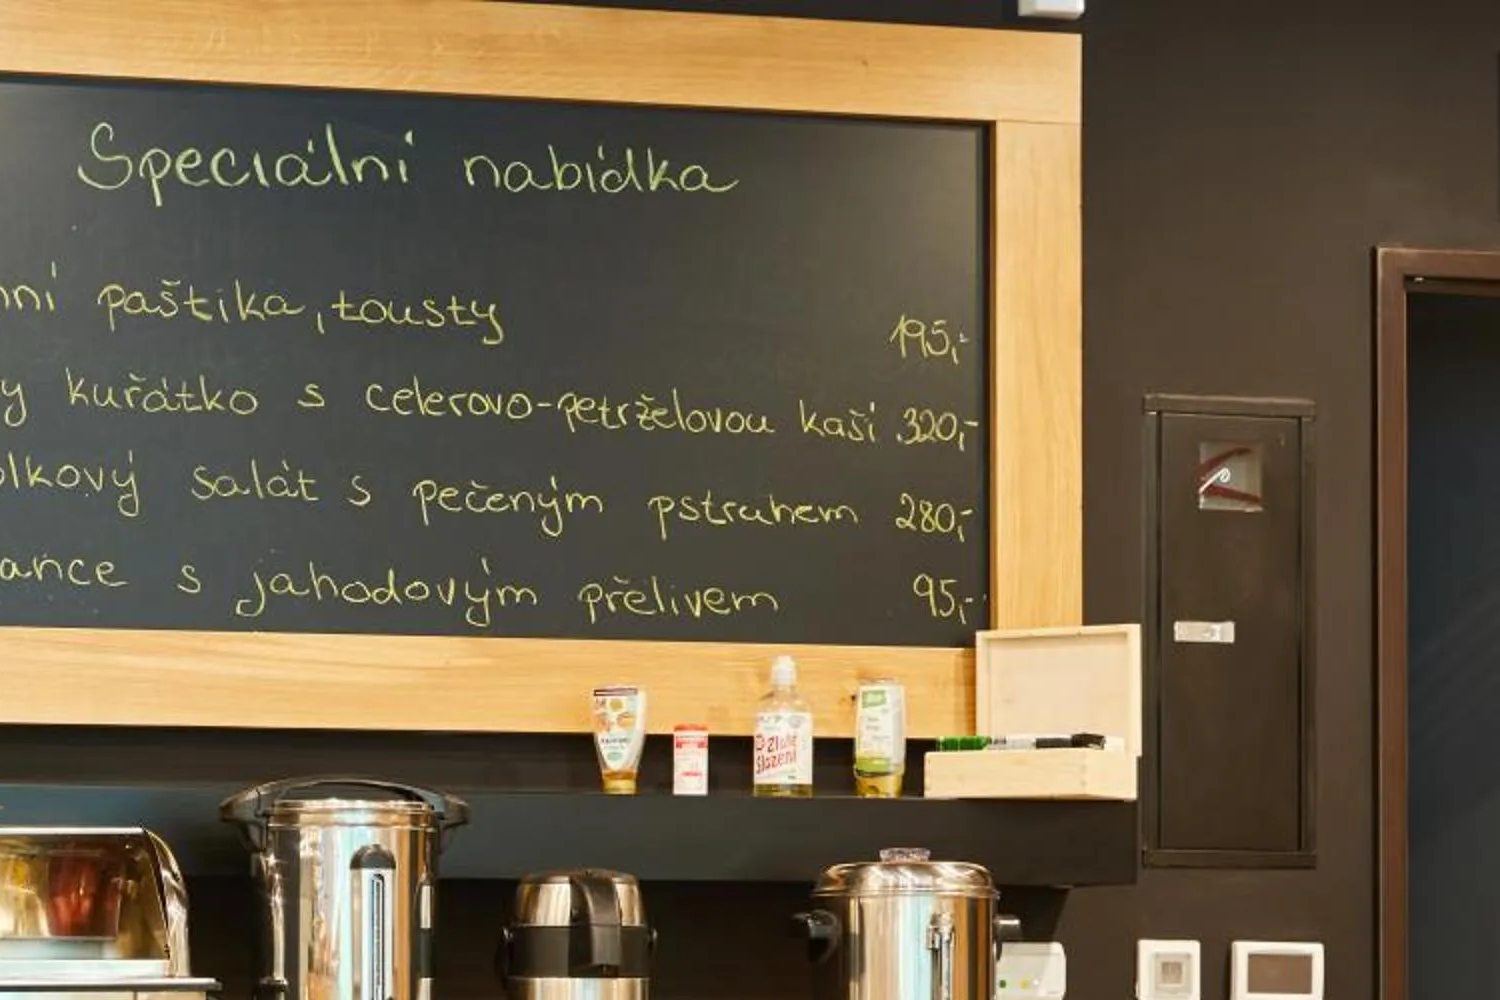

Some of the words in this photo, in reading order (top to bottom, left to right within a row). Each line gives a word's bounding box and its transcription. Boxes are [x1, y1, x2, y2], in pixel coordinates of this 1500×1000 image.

[462, 142, 741, 195] nabídka
[330, 289, 505, 347] tousty
[888, 313, 970, 367] 195,-
[64, 366, 260, 417] kuřátko
[295, 382, 327, 409] s
[894, 406, 980, 453] 320,-
[190, 457, 320, 502] salát
[346, 474, 373, 508] s
[410, 474, 605, 539] pečeným
[645, 488, 860, 542] pstruhem
[894, 491, 974, 544] 280,-
[176, 563, 202, 595] s
[234, 556, 539, 629] jahodovým
[576, 574, 780, 626] přelivem
[911, 572, 975, 626] 95,-
